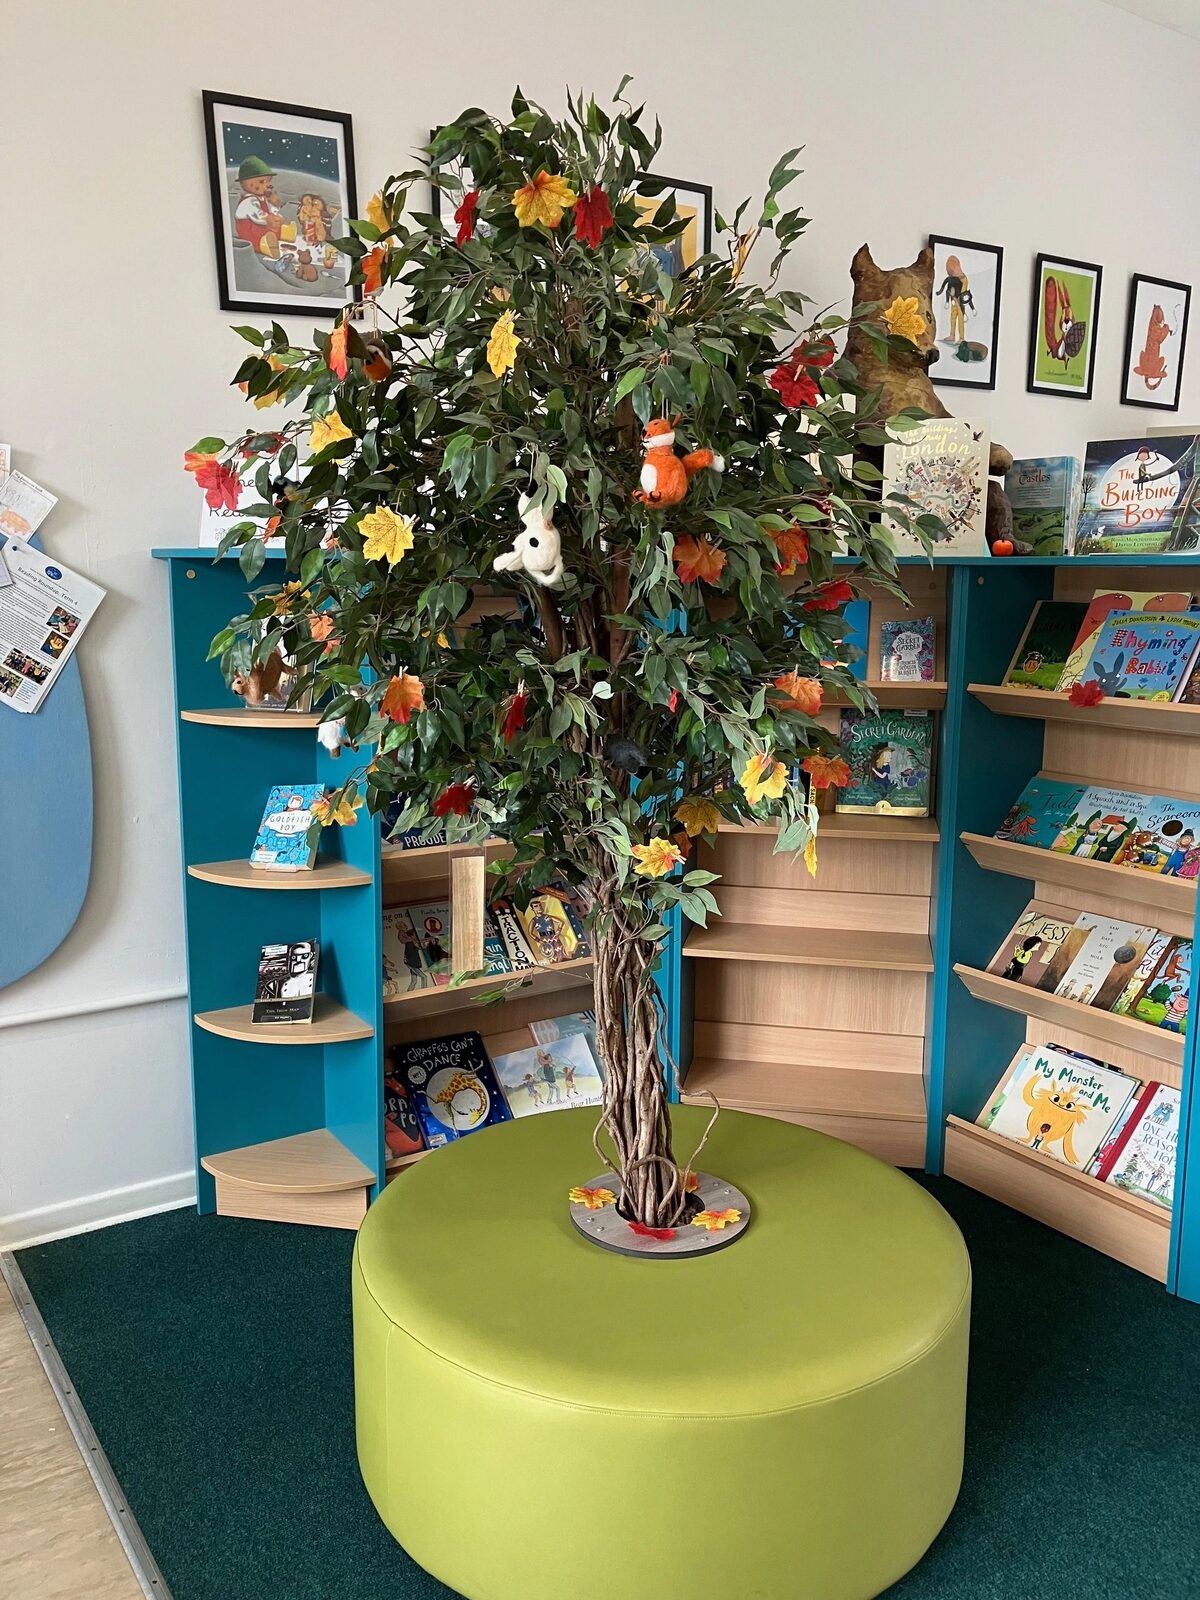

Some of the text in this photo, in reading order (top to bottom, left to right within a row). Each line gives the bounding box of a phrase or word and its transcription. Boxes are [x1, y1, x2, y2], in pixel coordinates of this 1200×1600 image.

[901, 433, 971, 459] London
[1019, 469, 1051, 485] Castles
[1118, 469, 1135, 480] The
[1101, 482, 1177, 507] BUILDING
[1117, 504, 1167, 528] BOY
[61, 593, 74, 603] Term
[1110, 629, 1193, 656] Rhyming
[1125, 656, 1177, 675] Rabbit
[851, 721, 927, 743] SECRET GARDEN
[1092, 793, 1115, 803] Squash
[1115, 798, 1130, 806] and
[1160, 802, 1176, 813] The
[270, 815, 311, 823] GOLDFISH
[501, 915, 532, 967] TRACTION
[407, 1037, 474, 1063] GIRAFFES CAN'T
[423, 1053, 461, 1072] DANCE
[1034, 1057, 1105, 1090] My Monster
[1078, 1086, 1111, 1114] and Me
[1142, 1121, 1162, 1138] ONE
[1142, 1133, 1175, 1153] REASO
